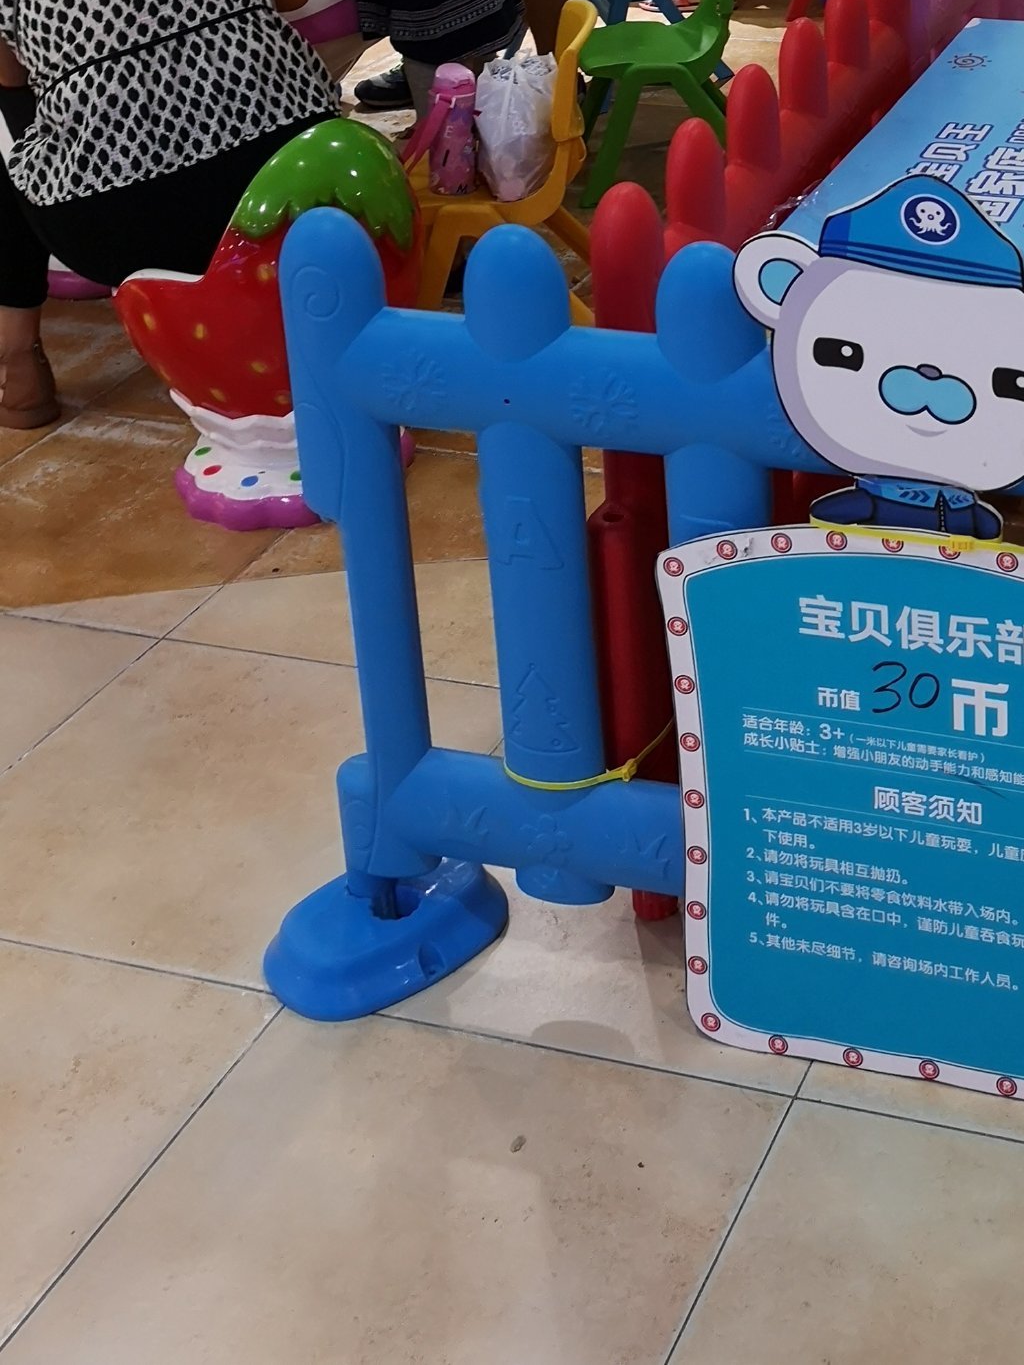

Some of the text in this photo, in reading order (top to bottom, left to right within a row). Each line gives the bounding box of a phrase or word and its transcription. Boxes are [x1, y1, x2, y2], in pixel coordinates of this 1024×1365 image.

[817, 660, 1011, 738] 币值 30 币
[873, 785, 984, 826] 顾客须知
[763, 828, 817, 851] 下使用。
